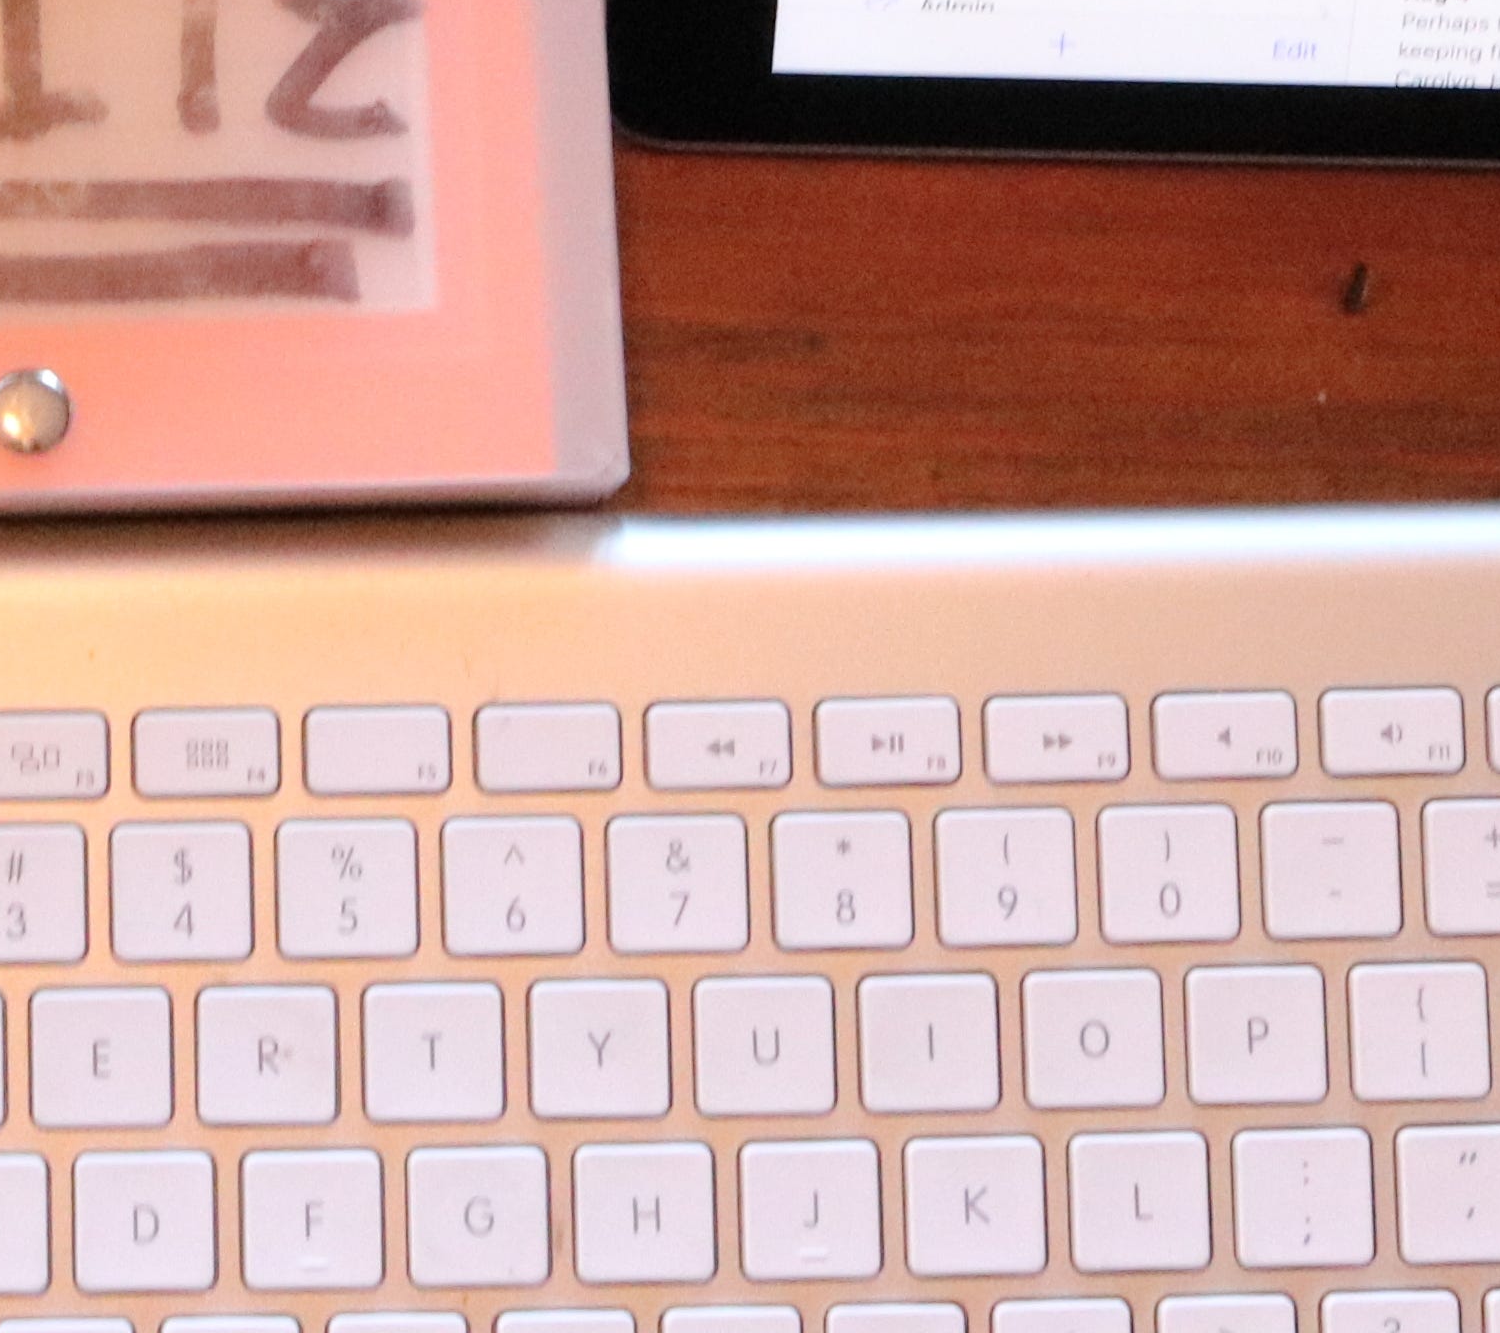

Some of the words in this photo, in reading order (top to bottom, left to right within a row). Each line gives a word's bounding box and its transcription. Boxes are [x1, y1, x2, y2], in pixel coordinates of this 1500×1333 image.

[1272, 39, 1318, 61] Edit
[6, 903, 28, 938] 3
[173, 902, 195, 937] 4
[340, 898, 359, 933] 5
[505, 896, 527, 932] 6
[671, 891, 691, 927] 7
[835, 889, 857, 924] 8
[996, 885, 1019, 920] 9
[91, 1040, 107, 1078] E
[257, 1037, 280, 1074] R
[423, 1033, 440, 1071] T
[587, 1030, 612, 1068] Y
[751, 1027, 781, 1065] U
[1078, 1020, 1111, 1058] O
[1246, 1017, 1270, 1055] P
[132, 1205, 161, 1244] D
[304, 1201, 320, 1240] F
[463, 1197, 496, 1235] G
[631, 1195, 662, 1235] H
[804, 1190, 820, 1229] J
[963, 1186, 990, 1225] K
[1133, 1182, 1151, 1221] L
